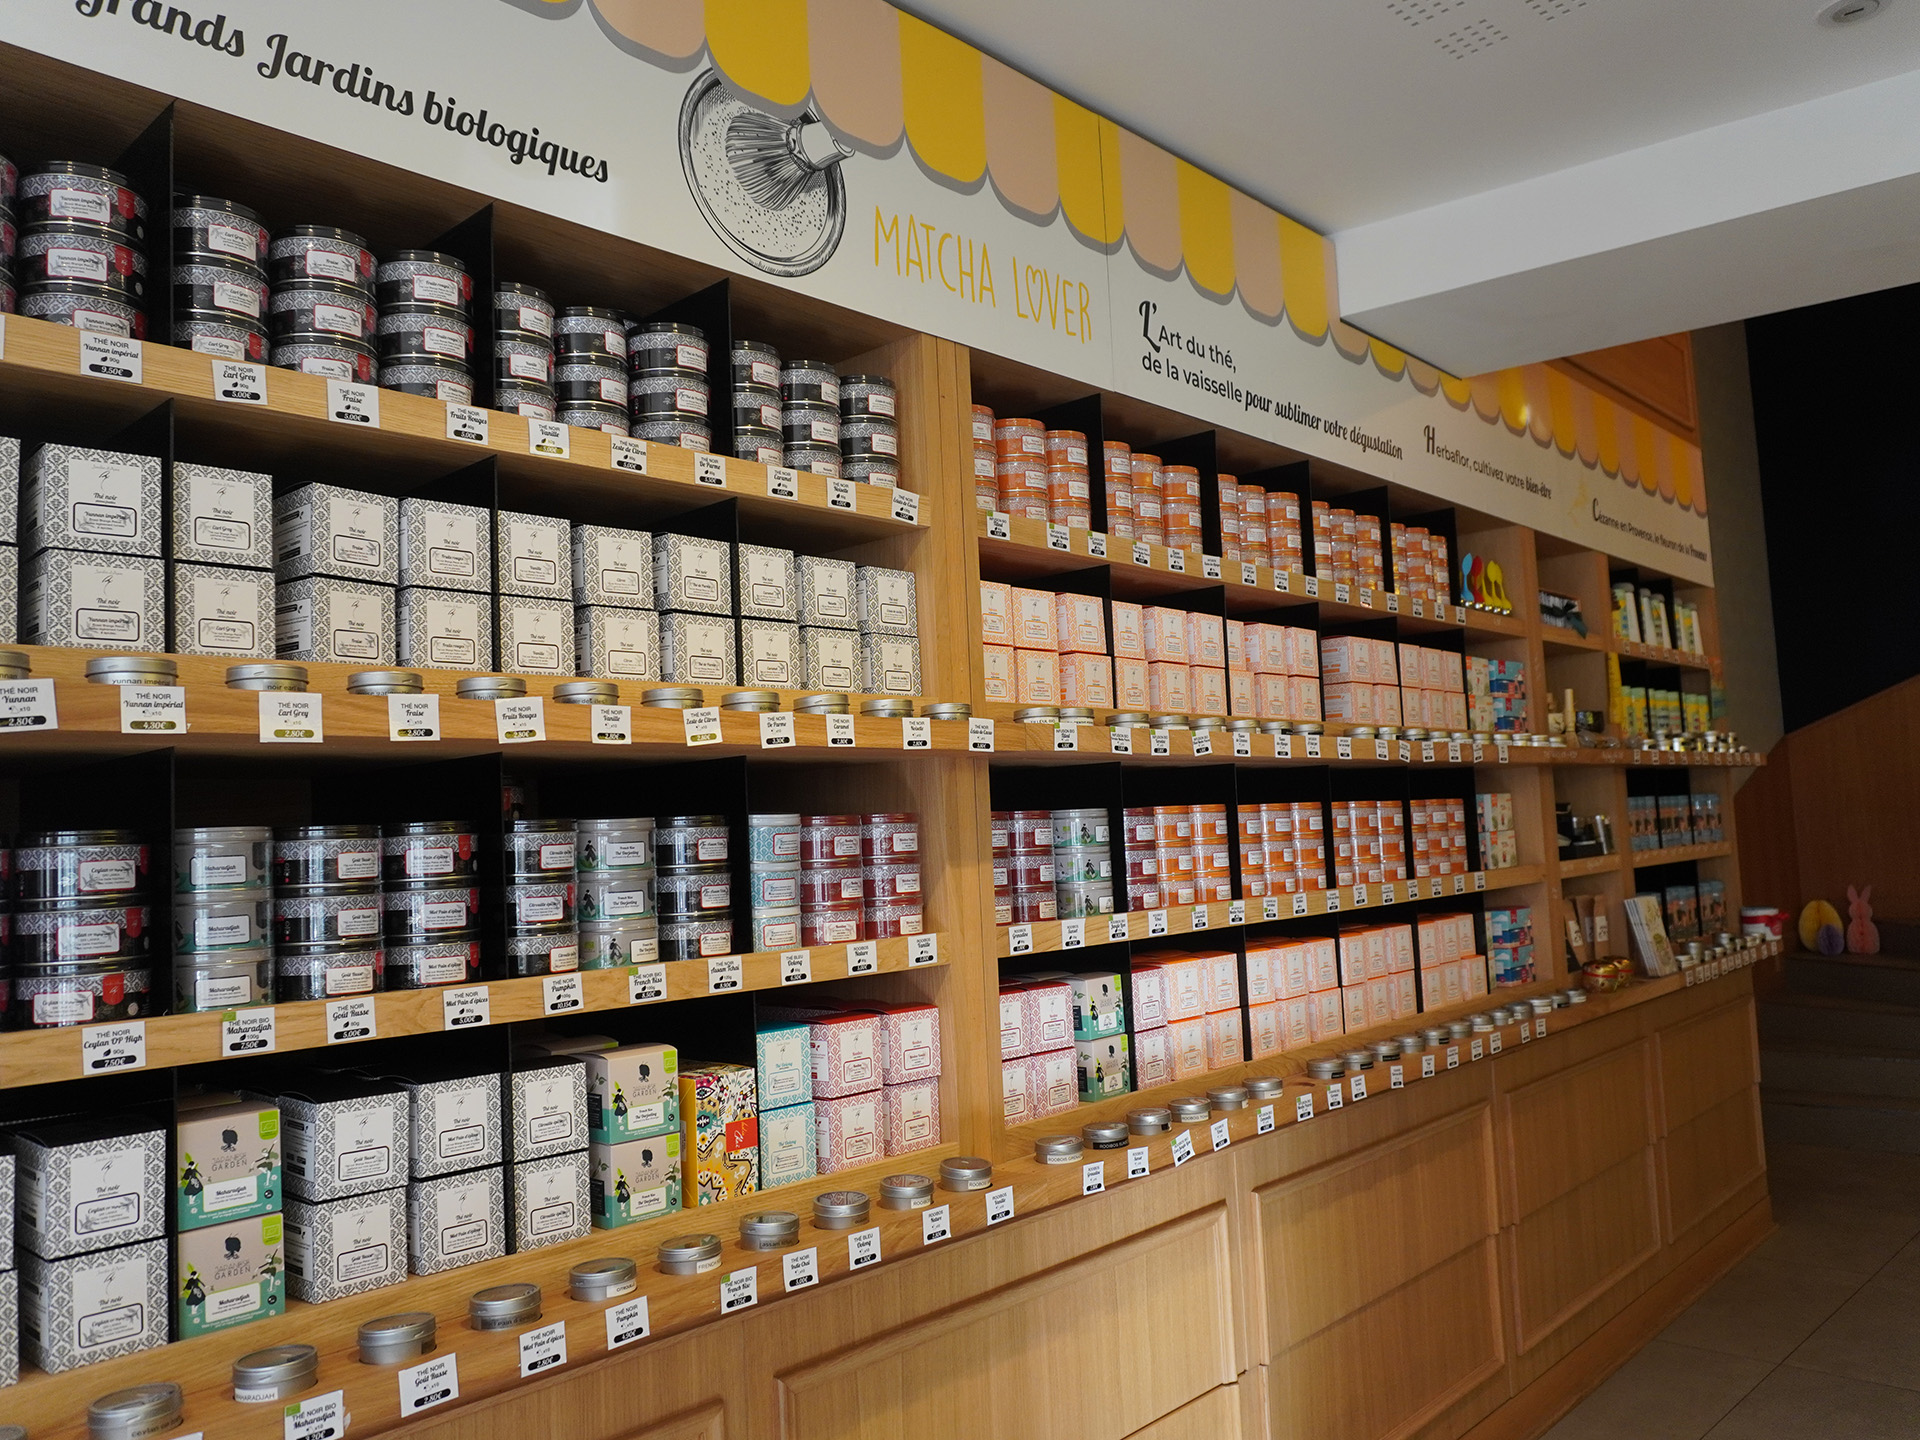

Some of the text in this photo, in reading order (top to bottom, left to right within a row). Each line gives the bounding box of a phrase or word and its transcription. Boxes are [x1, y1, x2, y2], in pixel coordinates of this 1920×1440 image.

[256, 33, 415, 116] Jardins
[423, 92, 609, 183] biologiques
[874, 205, 996, 308] MATCHA
[93, 337, 130, 349] THÉ NOIR
[84, 343, 140, 359] Yunnan impérial
[1186, 335, 1205, 359] du
[1209, 344, 1237, 373] thé,
[224, 365, 237, 373] THÉ
[223, 370, 256, 383] Earl Grey
[339, 388, 350, 396] THÉ
[343, 395, 363, 404] Fraise
[1141, 352, 1403, 461] de la vaisselle pour sublimer votre dégustation
[450, 411, 488, 425] Fruits Rouges
[1473, 459, 1504, 481] cultivez
[1505, 472, 1525, 488] votre
[0, 687, 38, 695] THÉ NOIR
[136, 692, 150, 700] THÉ
[2, 694, 37, 704] Yunnan
[123, 700, 184, 709] Yunnan impérial
[278, 709, 309, 719] Earl Grey
[406, 709, 425, 717] Fraise
[518, 712, 537, 721] Rouges
[551, 982, 576, 993] Pumpkin
[634, 978, 650, 986] French
[332, 1009, 370, 1021] Goût Russe
[96, 1028, 130, 1039] THÉ NOIR
[227, 1024, 272, 1035] Maharadjah
[84, 1039, 109, 1049] Ceylan
[125, 1035, 143, 1044] High
[212, 1160, 248, 1172] GARDEN
[214, 1265, 251, 1280] GARDEN
[625, 1304, 638, 1312] NOIR
[616, 1311, 639, 1323] Pumpkin
[530, 1329, 556, 1342] THÉ NOIR
[416, 1362, 445, 1377] THÉ NOIR
[414, 1370, 448, 1387] Goût Russe
[292, 1403, 337, 1422] THÉ NOIR BIO
[293, 1410, 336, 1430] Maharadjah
